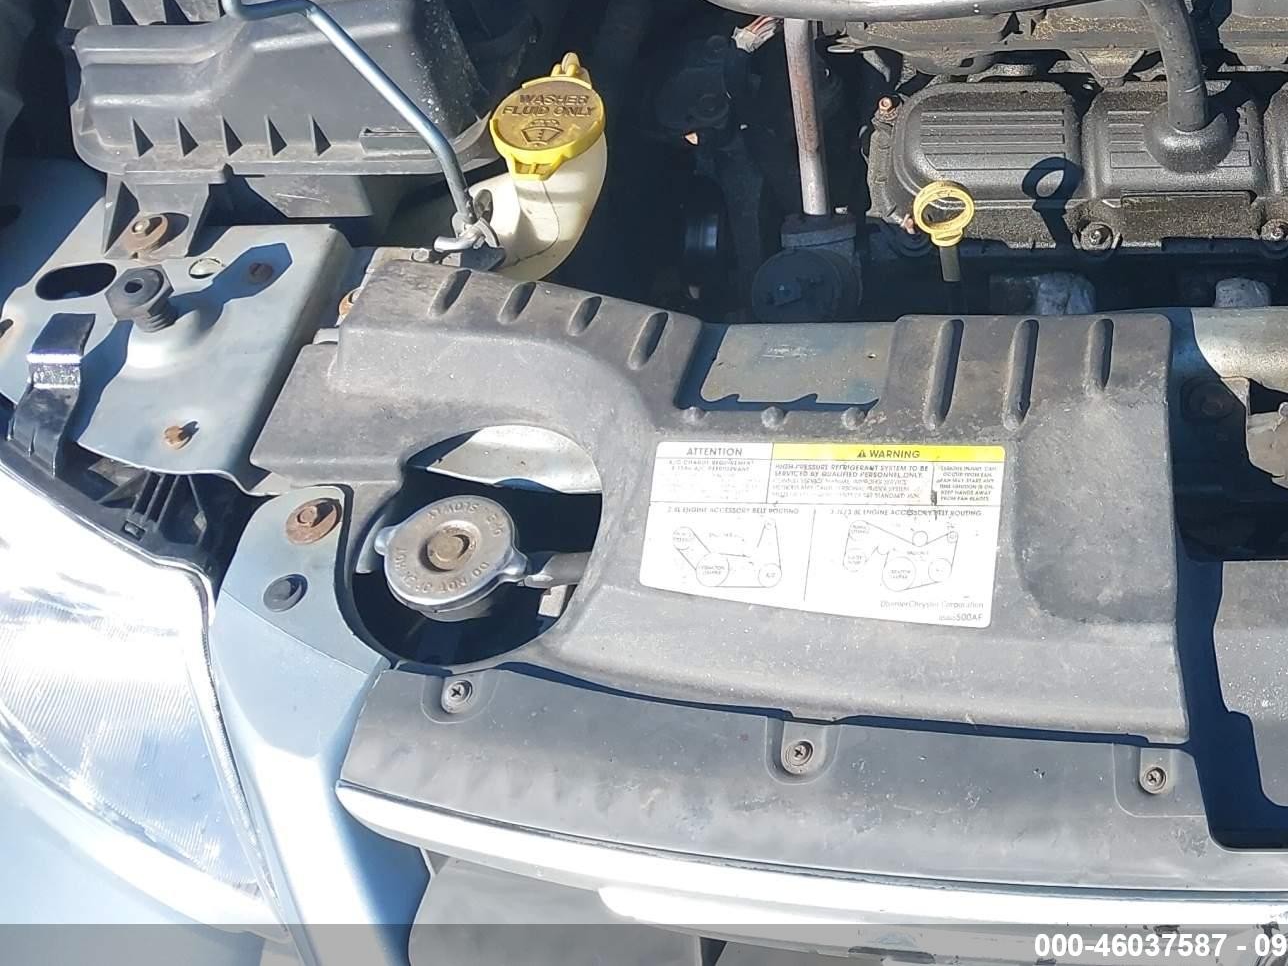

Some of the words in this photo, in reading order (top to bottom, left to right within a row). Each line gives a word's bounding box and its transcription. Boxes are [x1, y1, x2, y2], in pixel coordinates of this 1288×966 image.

[520, 94, 590, 105] WASHER
[502, 106, 550, 116] FLUID
[554, 107, 597, 116] ONLY
[686, 448, 743, 456] ATTENTION
[870, 450, 920, 458] WARNING
